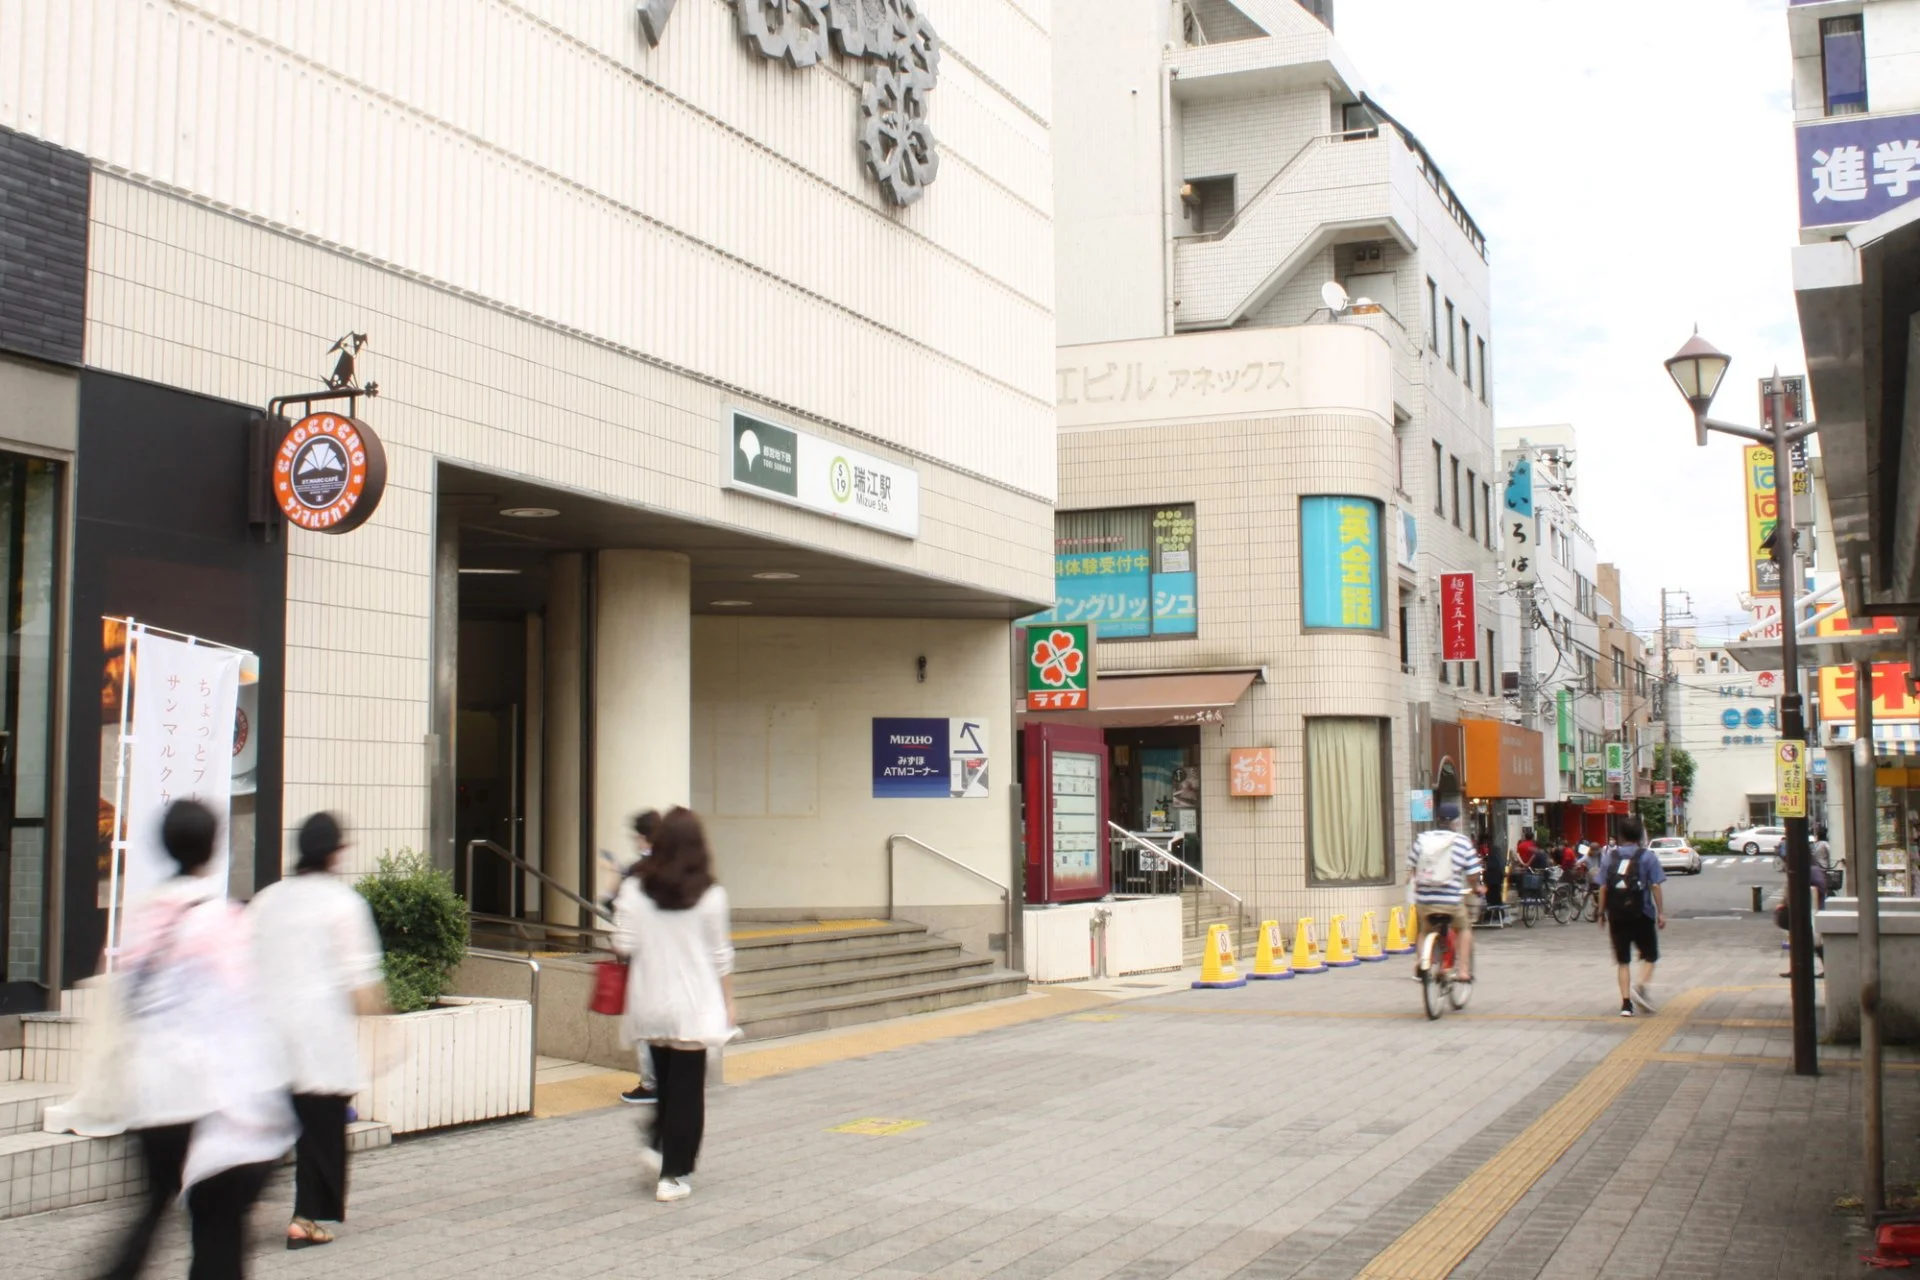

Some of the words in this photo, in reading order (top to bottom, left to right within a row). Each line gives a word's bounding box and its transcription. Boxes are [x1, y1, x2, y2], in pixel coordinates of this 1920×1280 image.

[1812, 139, 1920, 204] 進学
[1168, 361, 1290, 398] アネックス
[838, 464, 844, 477] S
[836, 478, 847, 492] 19
[854, 466, 892, 500] 瑞江駅
[856, 493, 876, 510] Mizue
[877, 499, 889, 513] Sta.
[1507, 496, 1529, 572] いろは
[1337, 504, 1373, 626] 英会話
[1034, 693, 1081, 707] ライフ
[889, 734, 933, 745] MIZUHO
[897, 756, 925, 765] みずほ
[884, 767, 939, 776] ATMコーナー
[1585, 771, 1602, 788] 花
